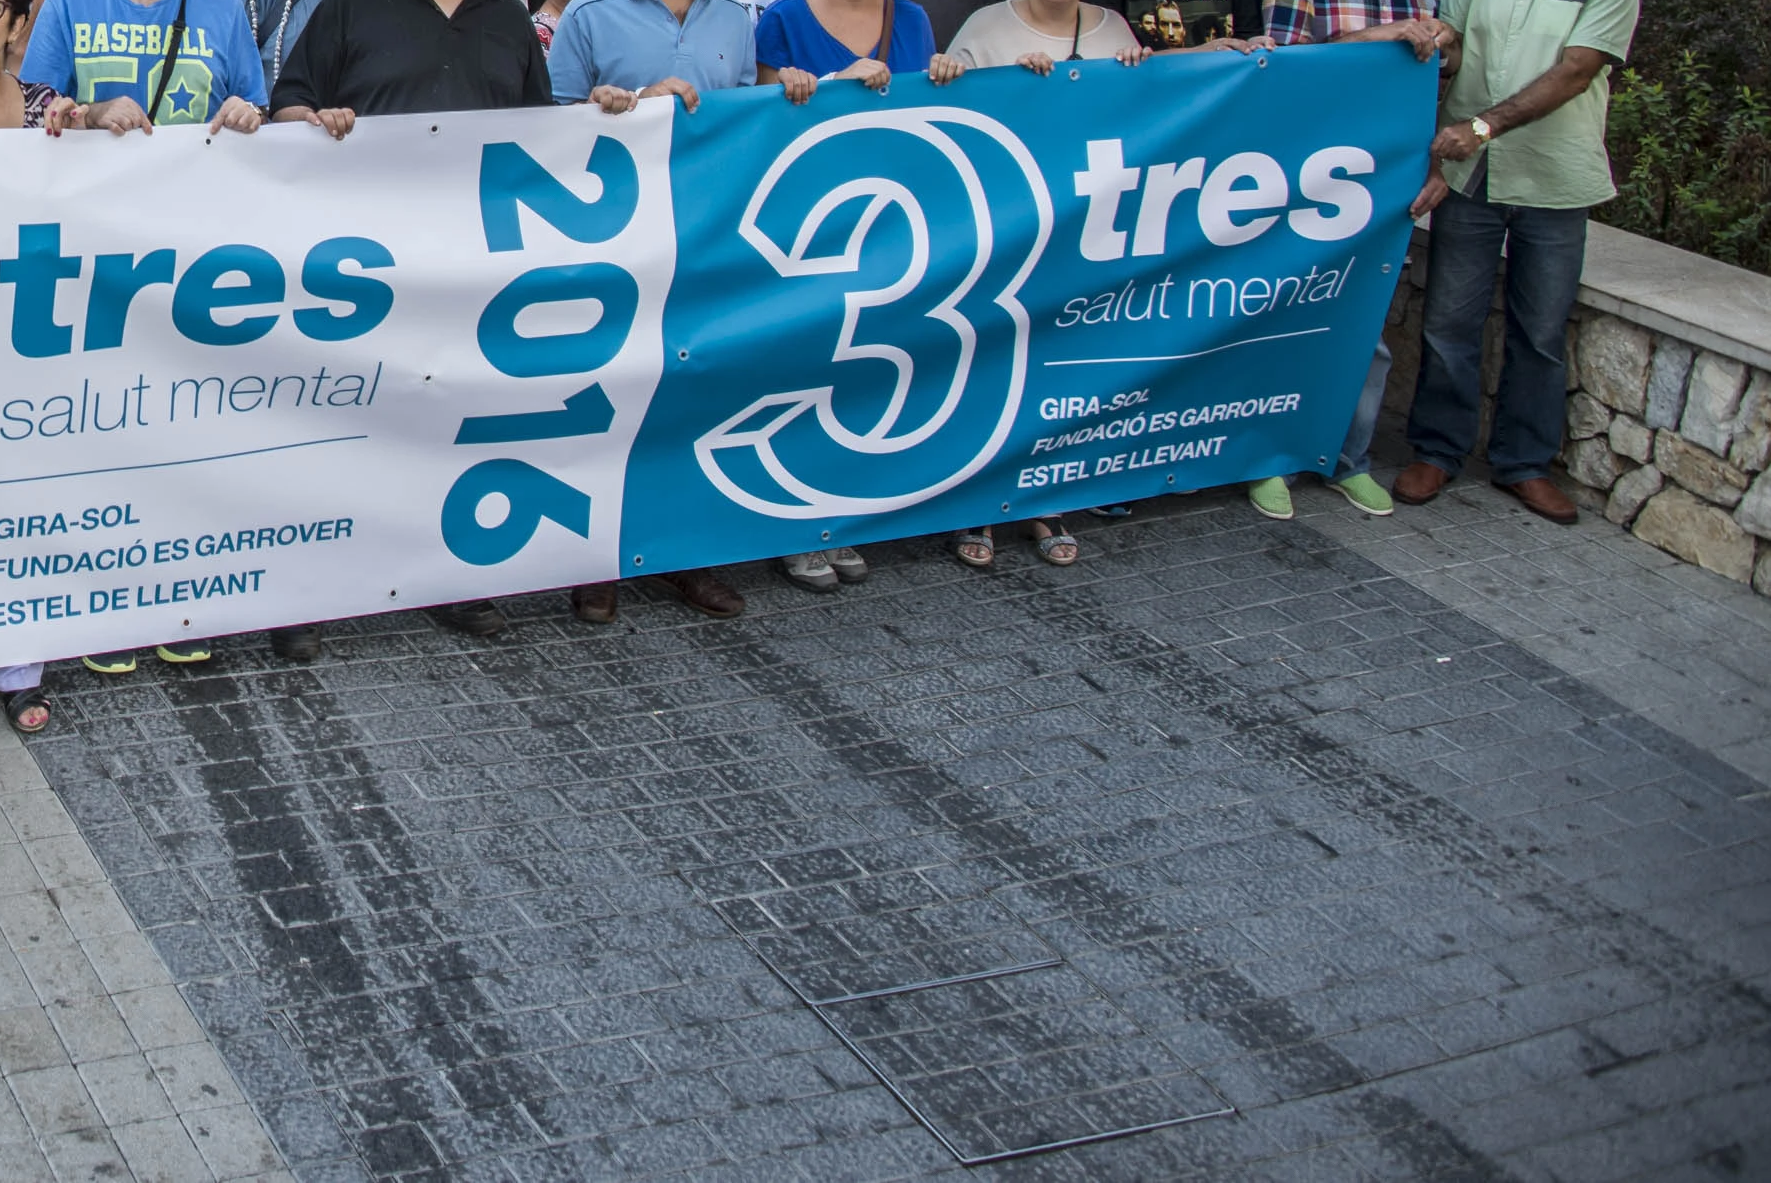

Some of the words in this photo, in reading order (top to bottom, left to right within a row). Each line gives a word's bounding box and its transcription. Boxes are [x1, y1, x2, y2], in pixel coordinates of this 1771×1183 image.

[1074, 138, 1375, 262] tres
[694, 106, 1054, 519] 3
[1055, 273, 1175, 328] salut
[1187, 256, 1357, 319] mental
[440, 134, 640, 566] 2016
[0, 373, 151, 441] salut
[169, 361, 383, 423] mental
[1030, 412, 1147, 456] FUNDACIÓ
[1148, 410, 1177, 434] ES
[1179, 393, 1301, 427] GARROVER
[1039, 388, 1151, 421] GIRA-SOL
[1017, 460, 1090, 489] ESTEL
[1095, 453, 1127, 476] DE
[1128, 436, 1228, 470] LLEVANT
[153, 538, 190, 564] ES
[194, 517, 354, 557] GARROVER
[89, 587, 130, 614] DE
[136, 569, 267, 607] LLEVANT
